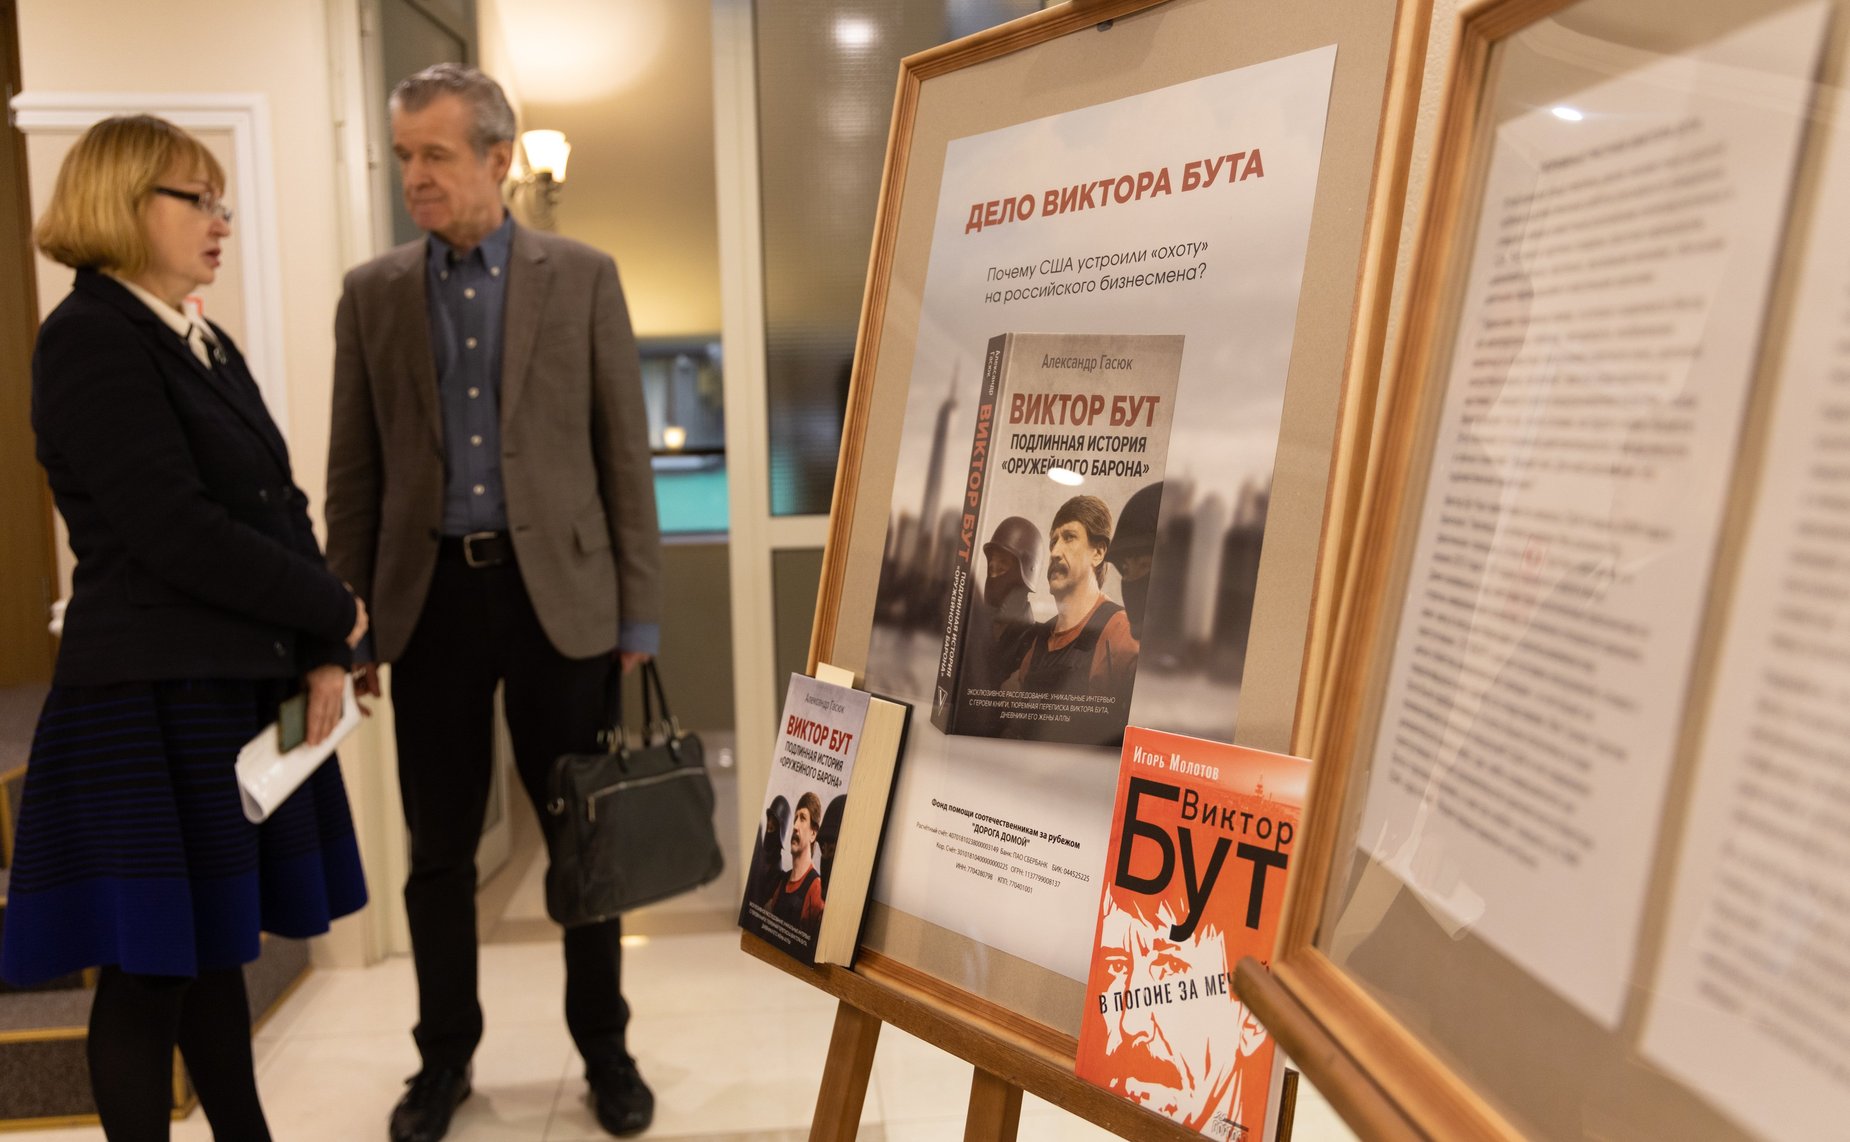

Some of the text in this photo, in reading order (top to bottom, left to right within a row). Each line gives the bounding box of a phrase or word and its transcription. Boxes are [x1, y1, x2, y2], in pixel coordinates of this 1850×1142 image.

[965, 148, 1265, 235] ДЕЛО ВИКТОРА БУТА
[987, 241, 1209, 282] Почему США устроили «охоту»
[985, 262, 1207, 305] на российского бизнесмена?
[1041, 353, 1133, 373] Александр Гасюк
[1009, 392, 1160, 427] ВИКТОР БУТ
[1010, 433, 1147, 453] ПОДЛИННАЯ ИСТОРИЯ
[958, 403, 993, 563] ВИКТОР БУТ
[1091, 459, 1150, 477] БАРОНА»
[946, 571, 967, 678] ПОДЛИННАЯ ИСТОРИЯ
[805, 693, 845, 714] Александр Гасюк
[1070, 705, 1094, 713] ВИКТОРА
[786, 714, 853, 755] ВИКТОР БУТ
[785, 741, 844, 772] ПОДЛИННАЯ ИСТОРИЯ
[931, 798, 1081, 849] Фонд помощи соотечественникам за рубежом
[1181, 788, 1293, 851] Виктор
[1012, 852, 1024, 861] ПАО
[1023, 855, 1049, 869] СБЕРБАНК
[1063, 868, 1090, 883] 044525225
[1114, 776, 1288, 943] Бут
[1099, 994, 1108, 1014] В
[1114, 983, 1173, 1012] ПОГОНЕ
[1178, 979, 1199, 1001] ЗА
